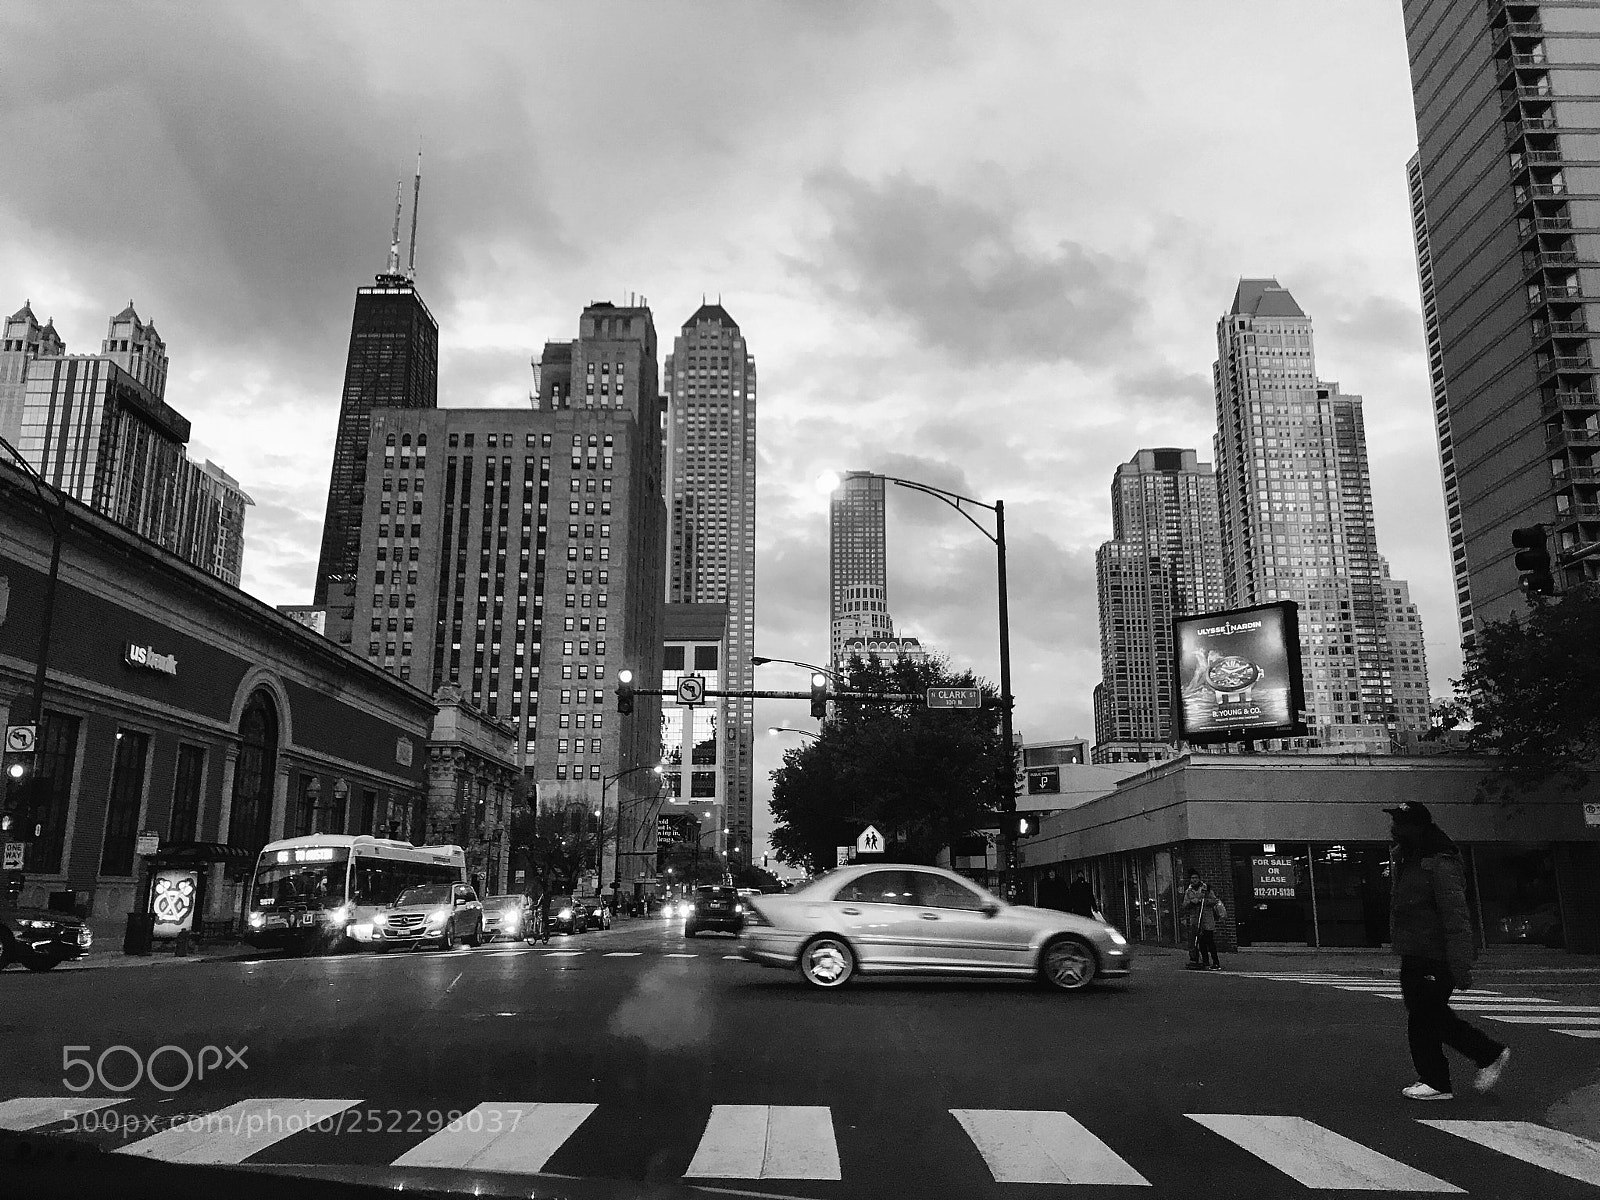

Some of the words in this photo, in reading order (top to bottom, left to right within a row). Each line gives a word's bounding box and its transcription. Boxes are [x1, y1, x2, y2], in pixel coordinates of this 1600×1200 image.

[1197, 627, 1226, 636] ULYSSE
[1230, 620, 1262, 631] NARDIN
[938, 690, 967, 699] CLARK
[1219, 708, 1242, 717] YOUNG
[5, 851, 20, 859] WAY
